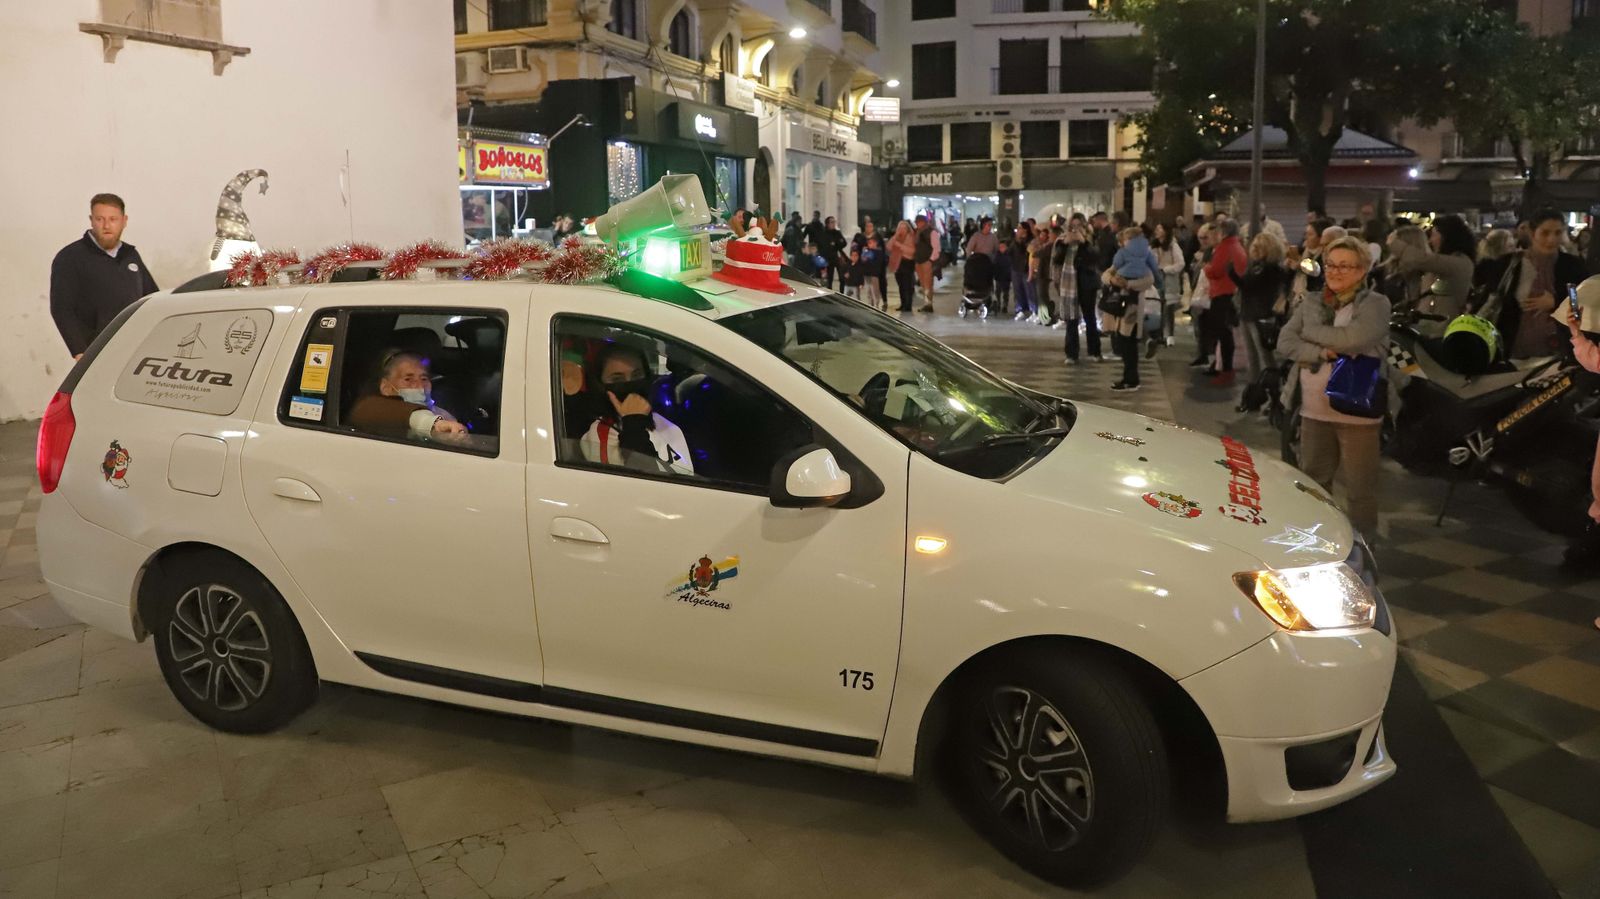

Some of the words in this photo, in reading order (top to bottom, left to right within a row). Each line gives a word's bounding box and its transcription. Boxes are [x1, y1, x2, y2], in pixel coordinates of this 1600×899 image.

[903, 172, 953, 188] FEMME
[681, 242, 701, 268] TAXI
[230, 329, 252, 340] 25
[133, 357, 233, 387] Futura
[678, 592, 731, 610] Algeciras
[839, 668, 875, 691] 175
